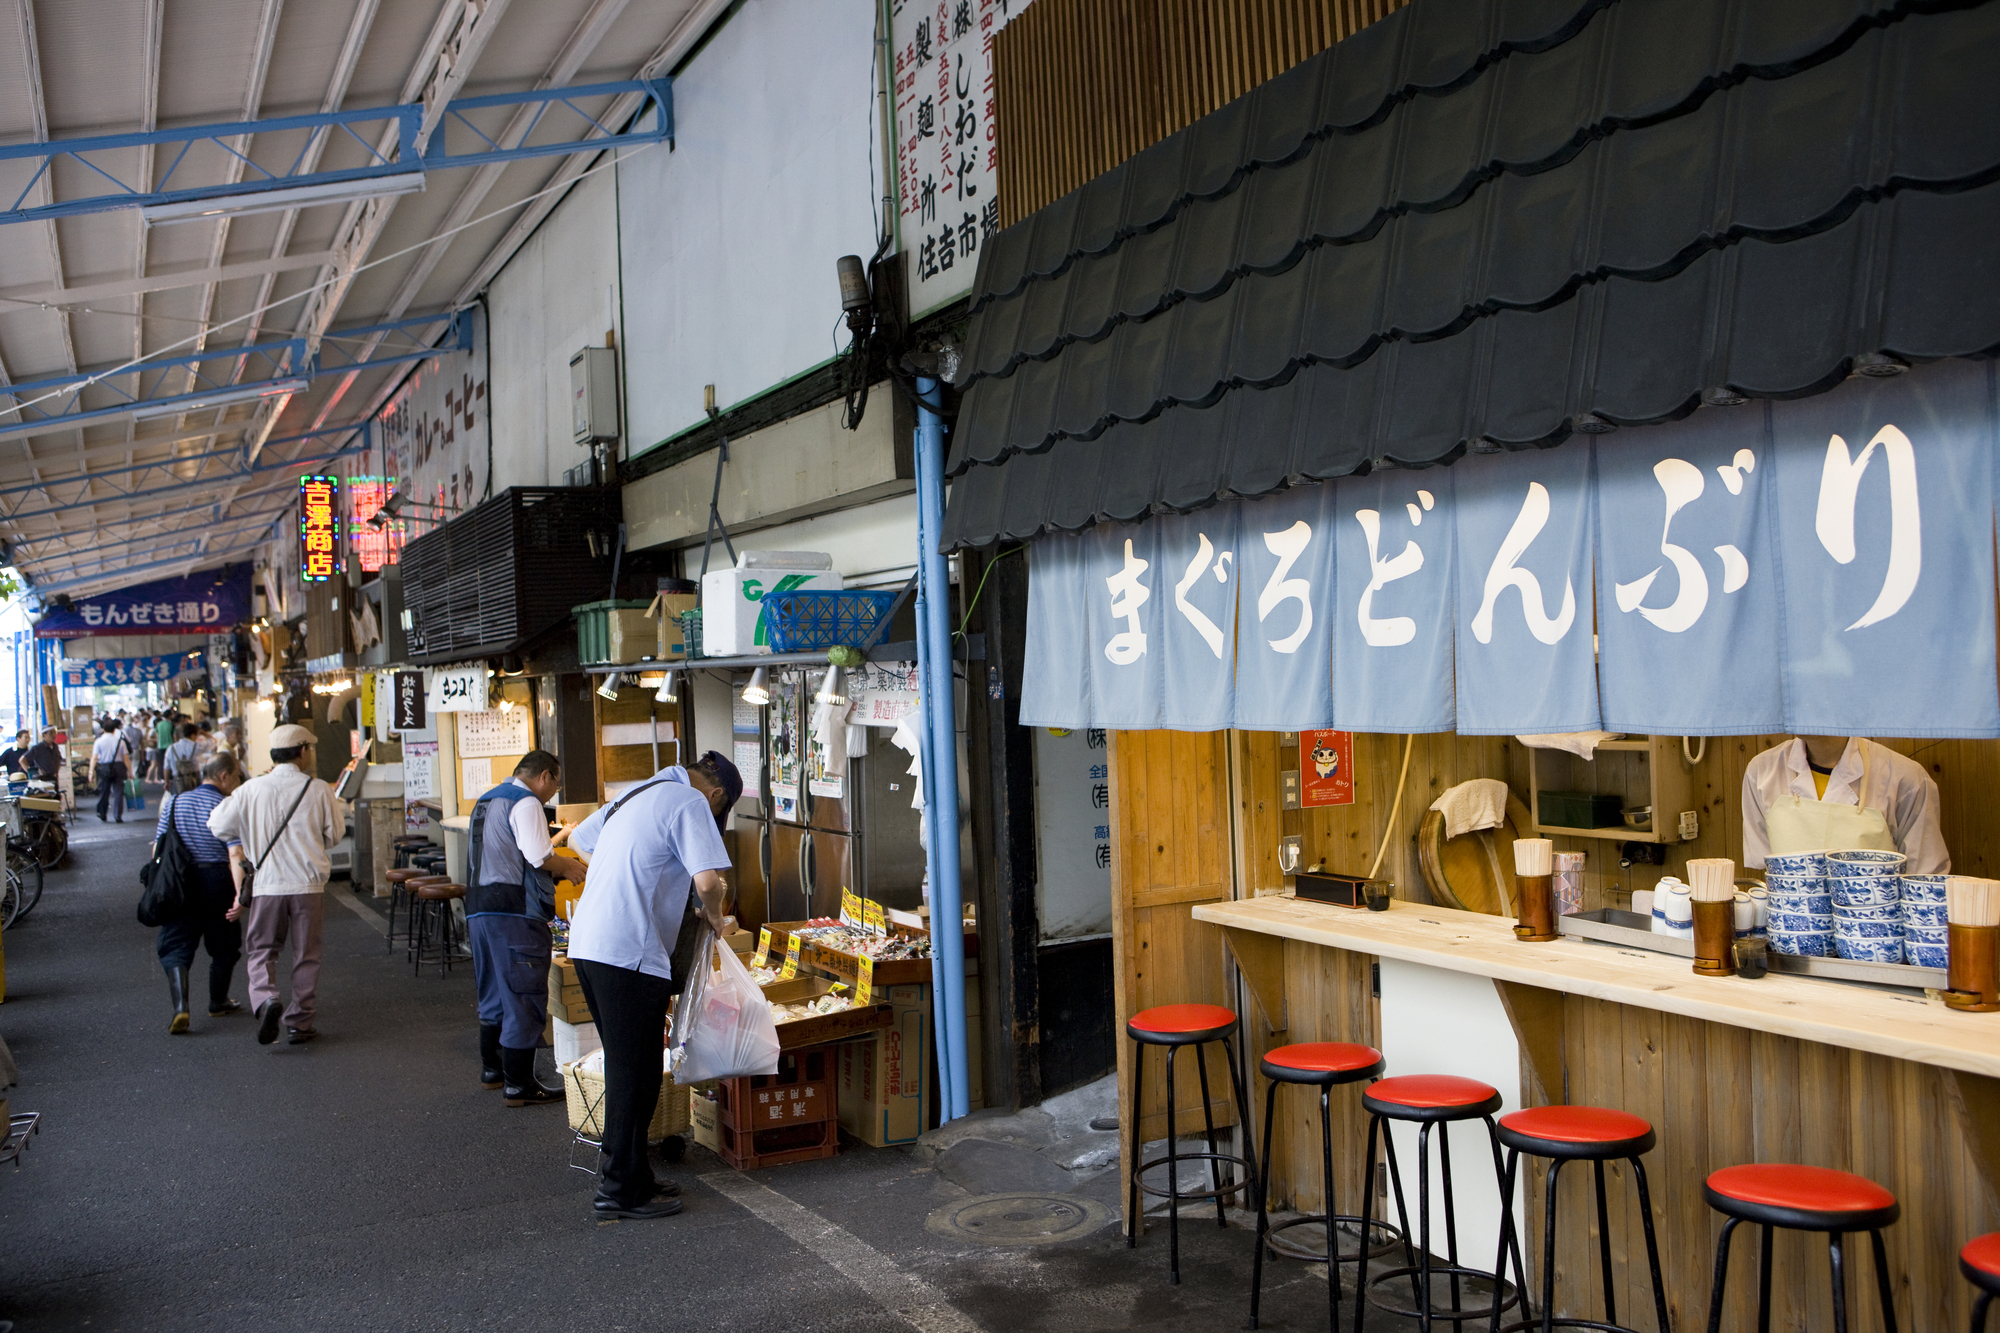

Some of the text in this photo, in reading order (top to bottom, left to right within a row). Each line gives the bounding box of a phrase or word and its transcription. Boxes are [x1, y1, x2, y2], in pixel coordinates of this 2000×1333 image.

[917, 194, 999, 283] 住吉市場
[305, 481, 333, 576] 吉澤商店
[1104, 423, 1922, 666] まぐろどんぶり
[80, 601, 220, 626] もんぜき通り
[401, 674, 416, 727] 焼肉ライス
[889, 1030, 901, 1096] チルドビーフ
